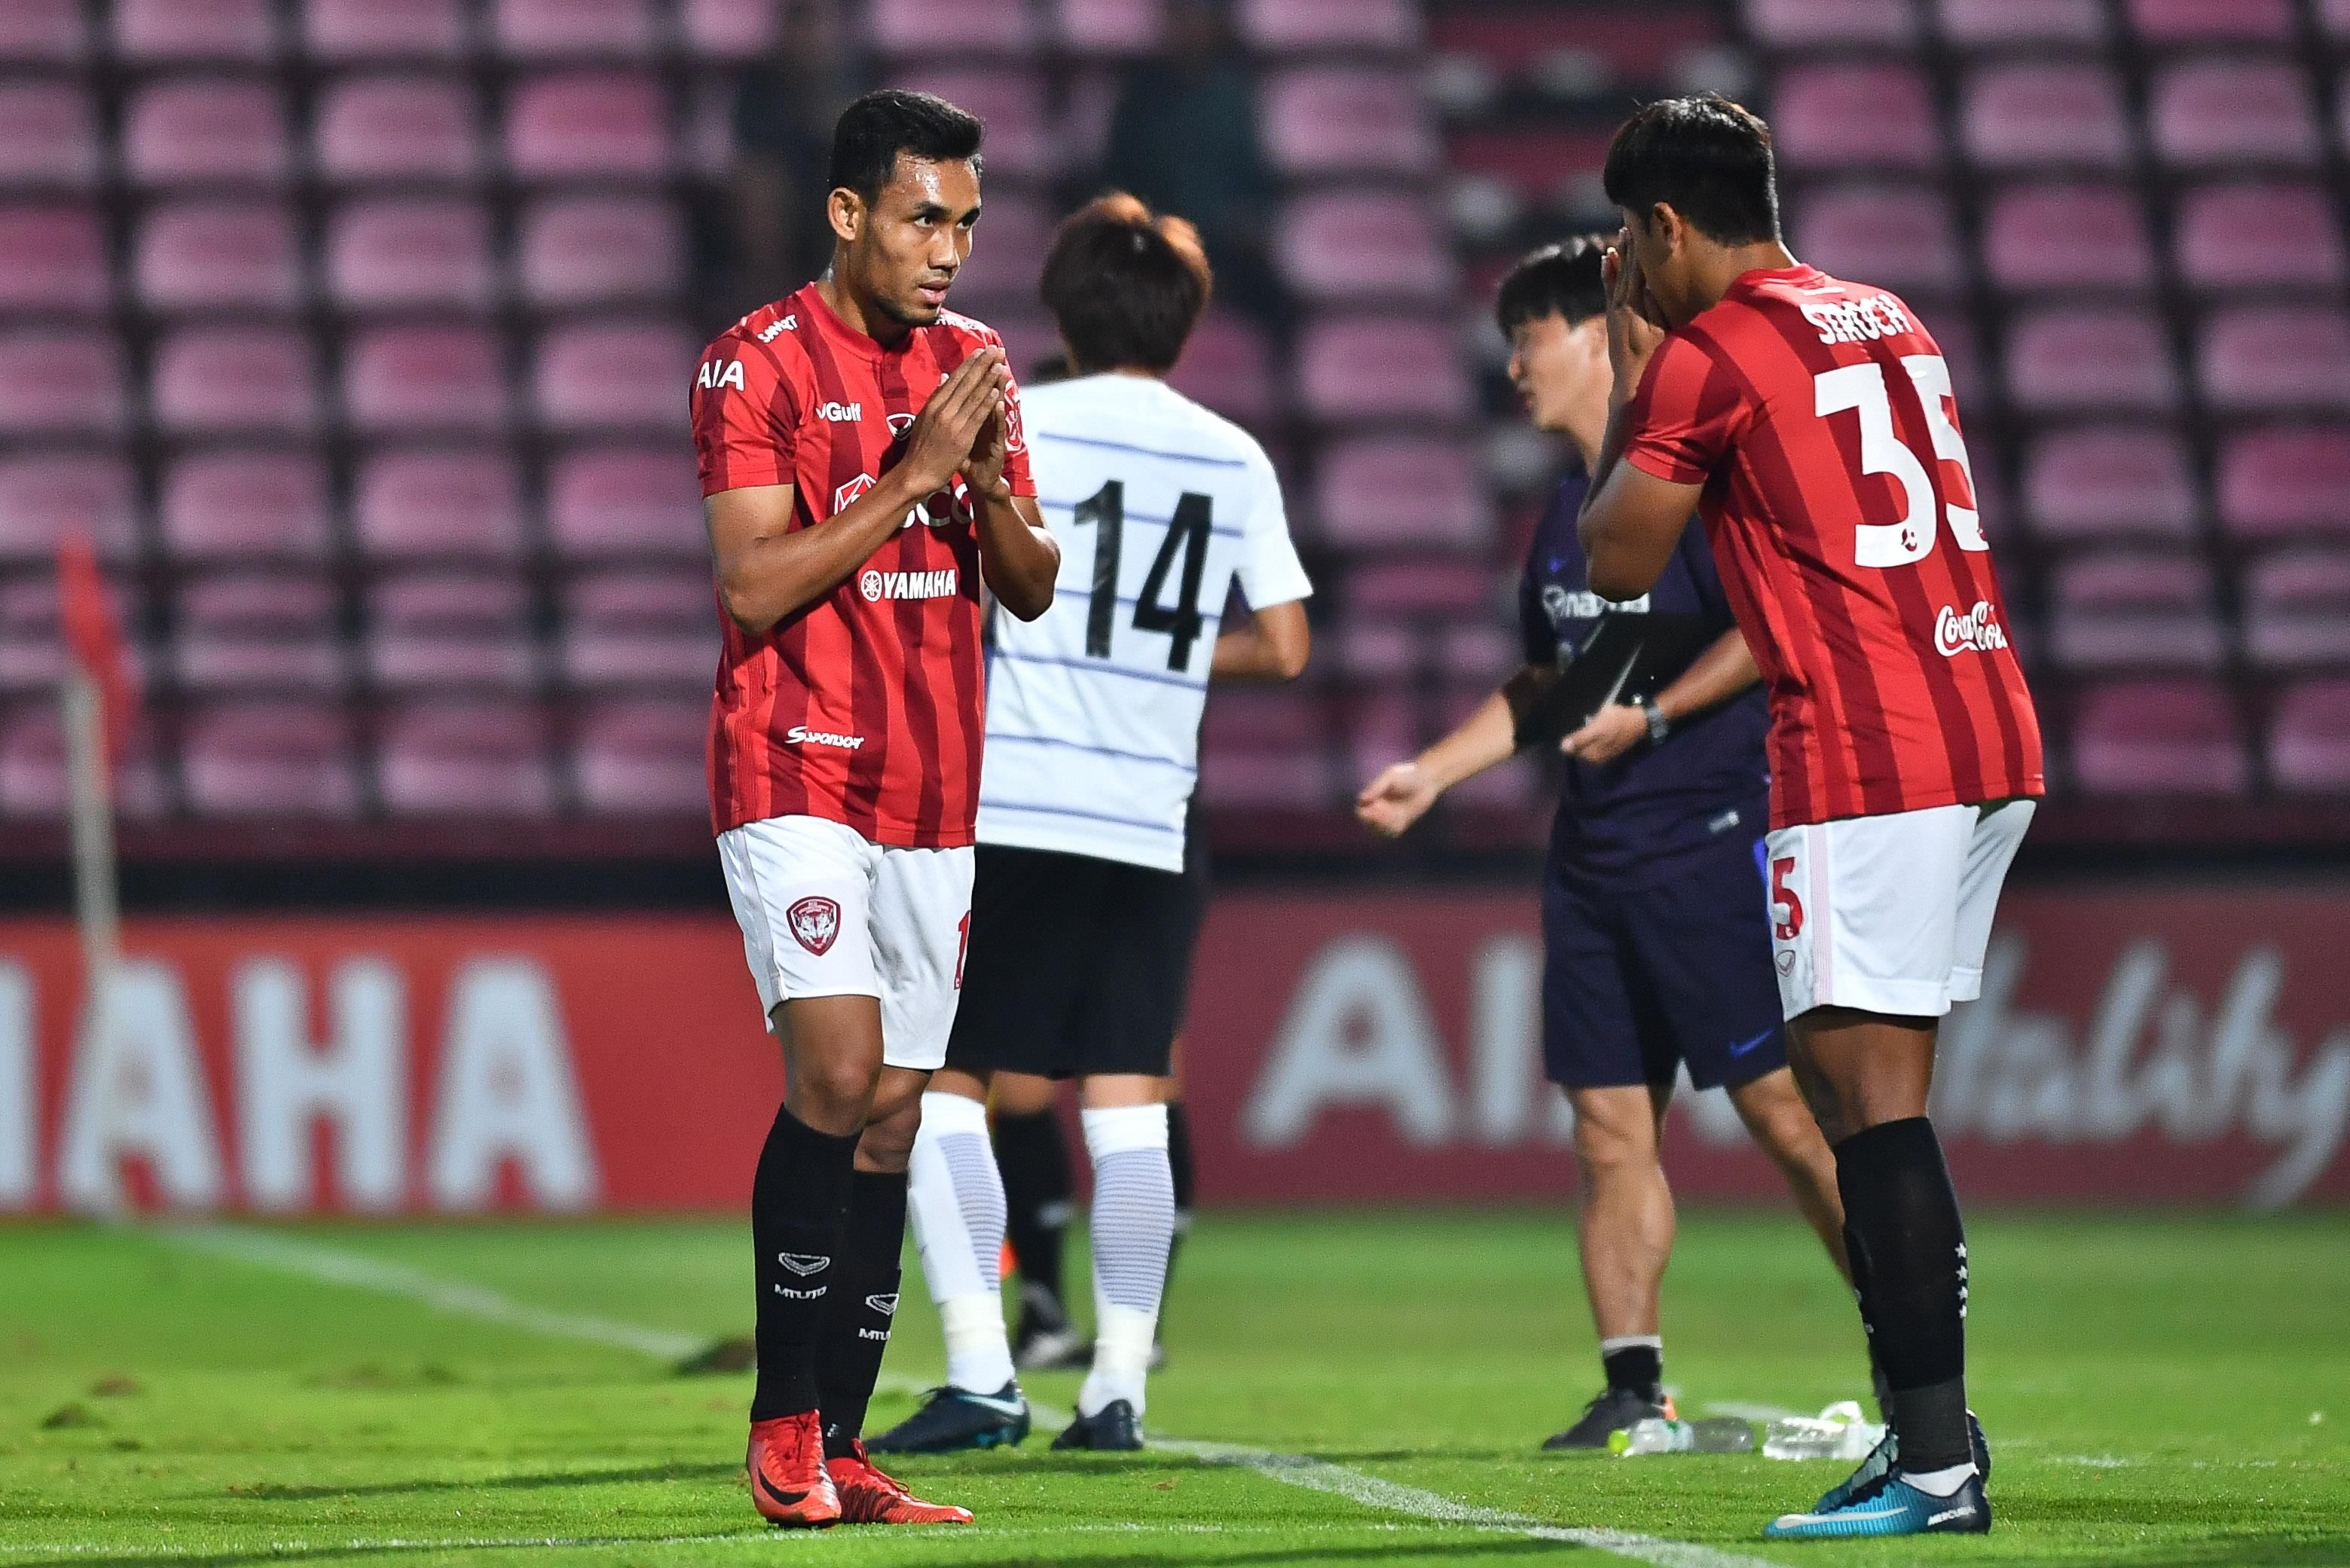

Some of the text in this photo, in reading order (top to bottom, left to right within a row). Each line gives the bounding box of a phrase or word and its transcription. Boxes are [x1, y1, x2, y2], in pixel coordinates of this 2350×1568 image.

[696, 359, 745, 392] AIA
[1814, 354, 1990, 567] 35
[884, 569, 956, 600] YAMAHA
[1074, 479, 1213, 672] 14
[1772, 856, 1803, 941] 5
